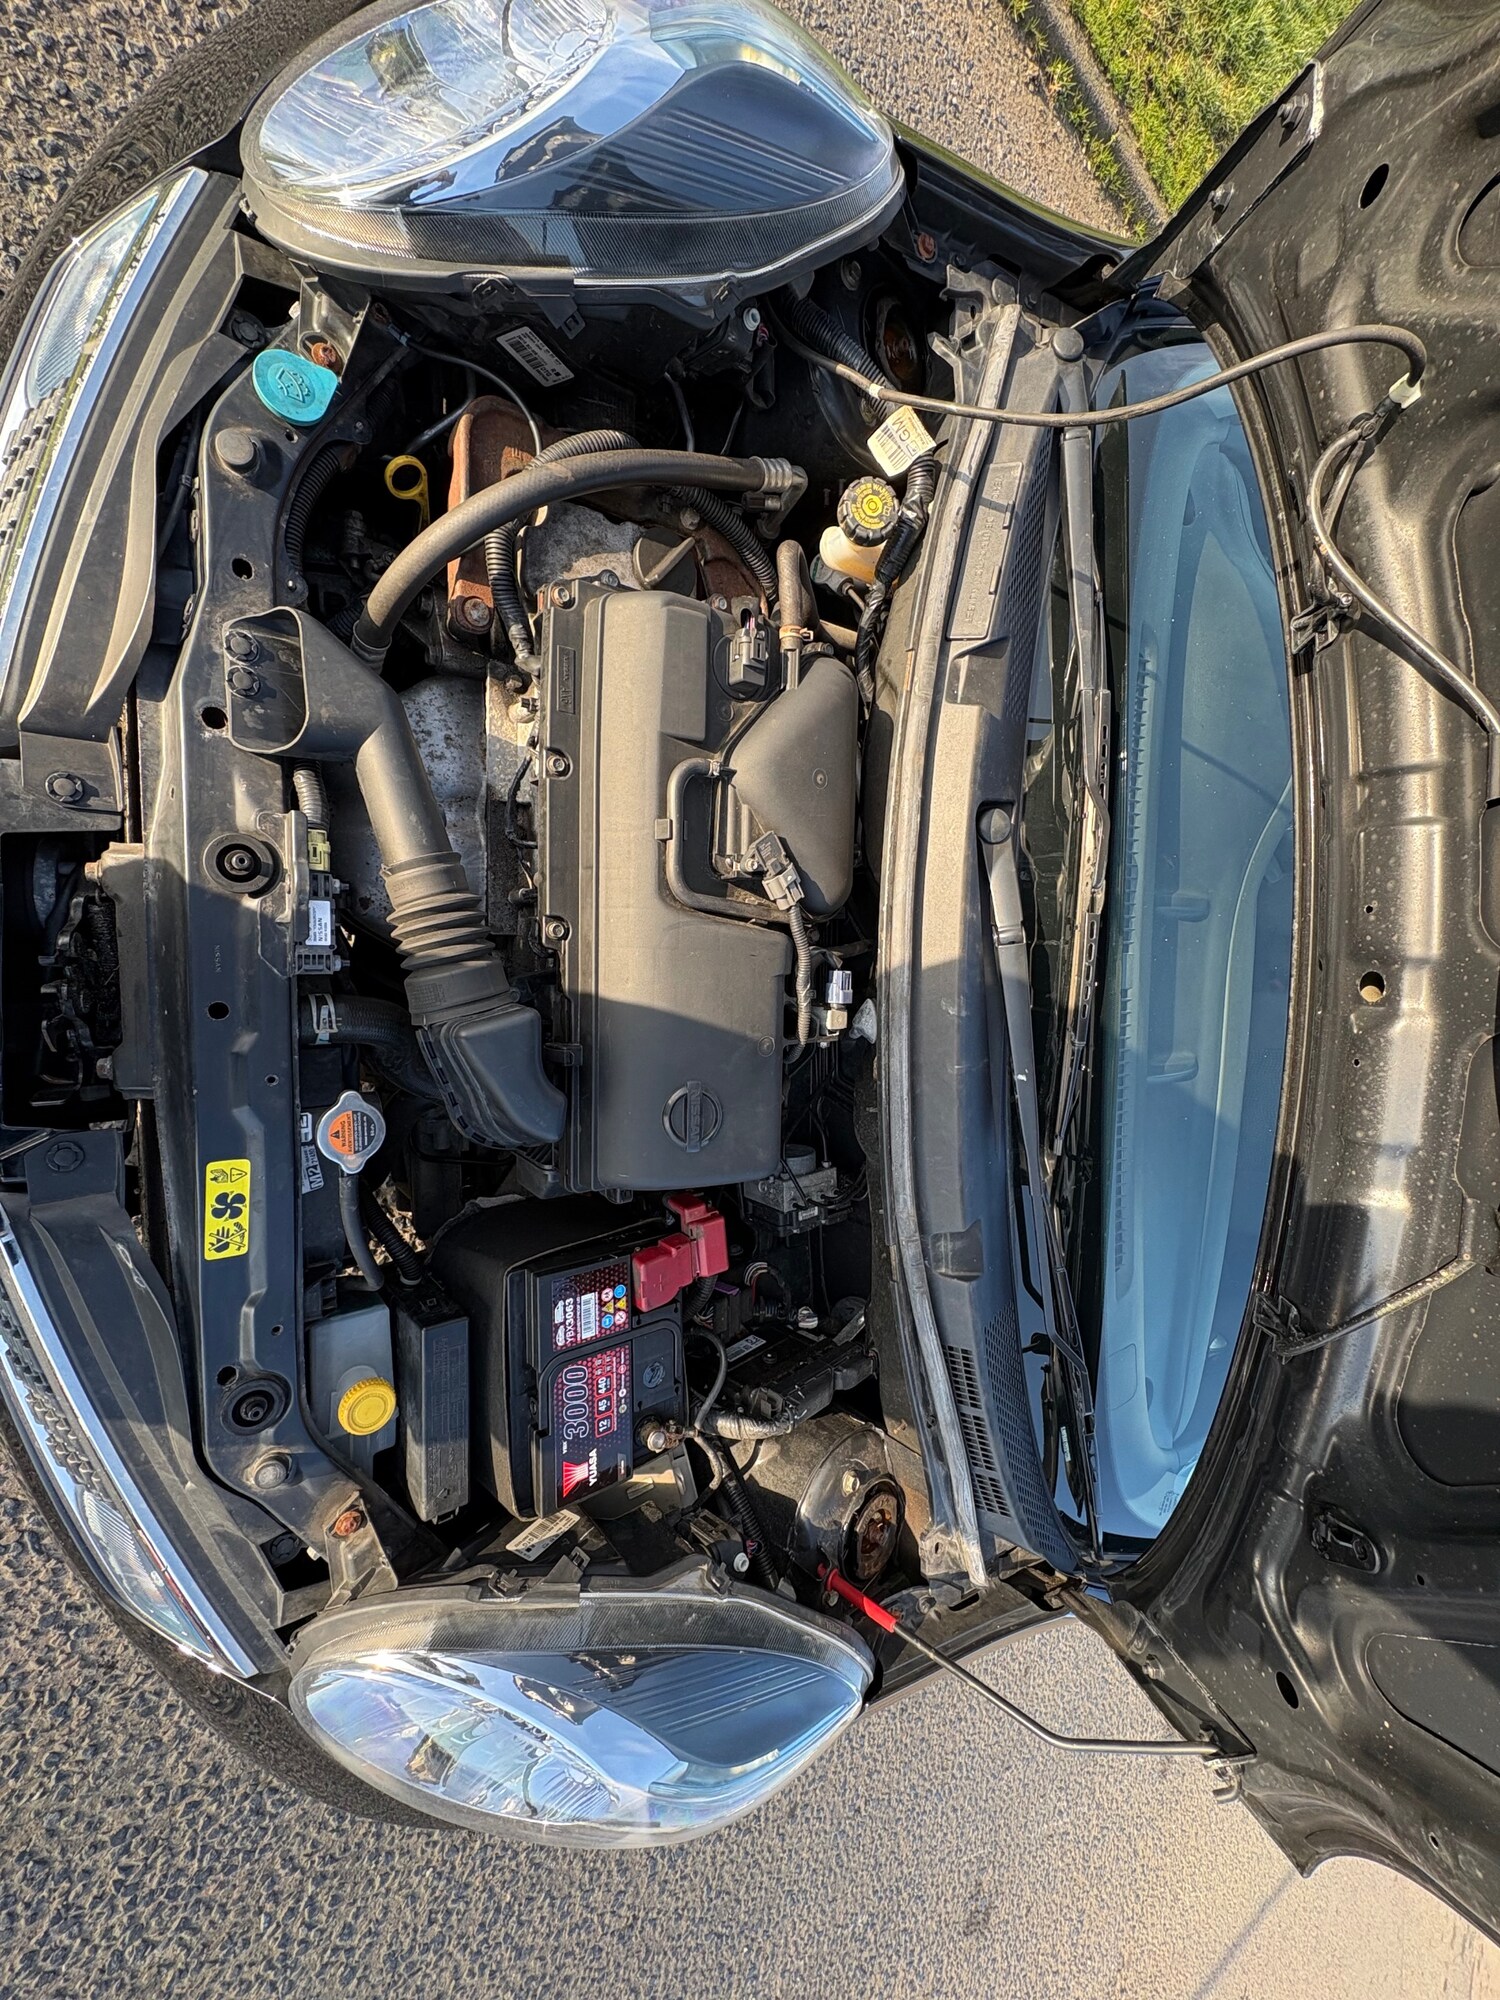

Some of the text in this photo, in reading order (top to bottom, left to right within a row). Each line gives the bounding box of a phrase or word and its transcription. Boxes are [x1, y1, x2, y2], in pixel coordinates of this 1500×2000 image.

[891, 417, 910, 442] GM
[689, 1088, 701, 1145] NISSAN
[340, 1120, 348, 1147] WARNING
[306, 1164, 323, 1189] M2
[565, 1297, 574, 1344] YBX3063
[598, 1376, 607, 1394] 440
[563, 1365, 589, 1440] 3000
[598, 1399, 607, 1411] 45
[599, 1419, 607, 1432] 12
[588, 1448, 598, 1487] YUASA
